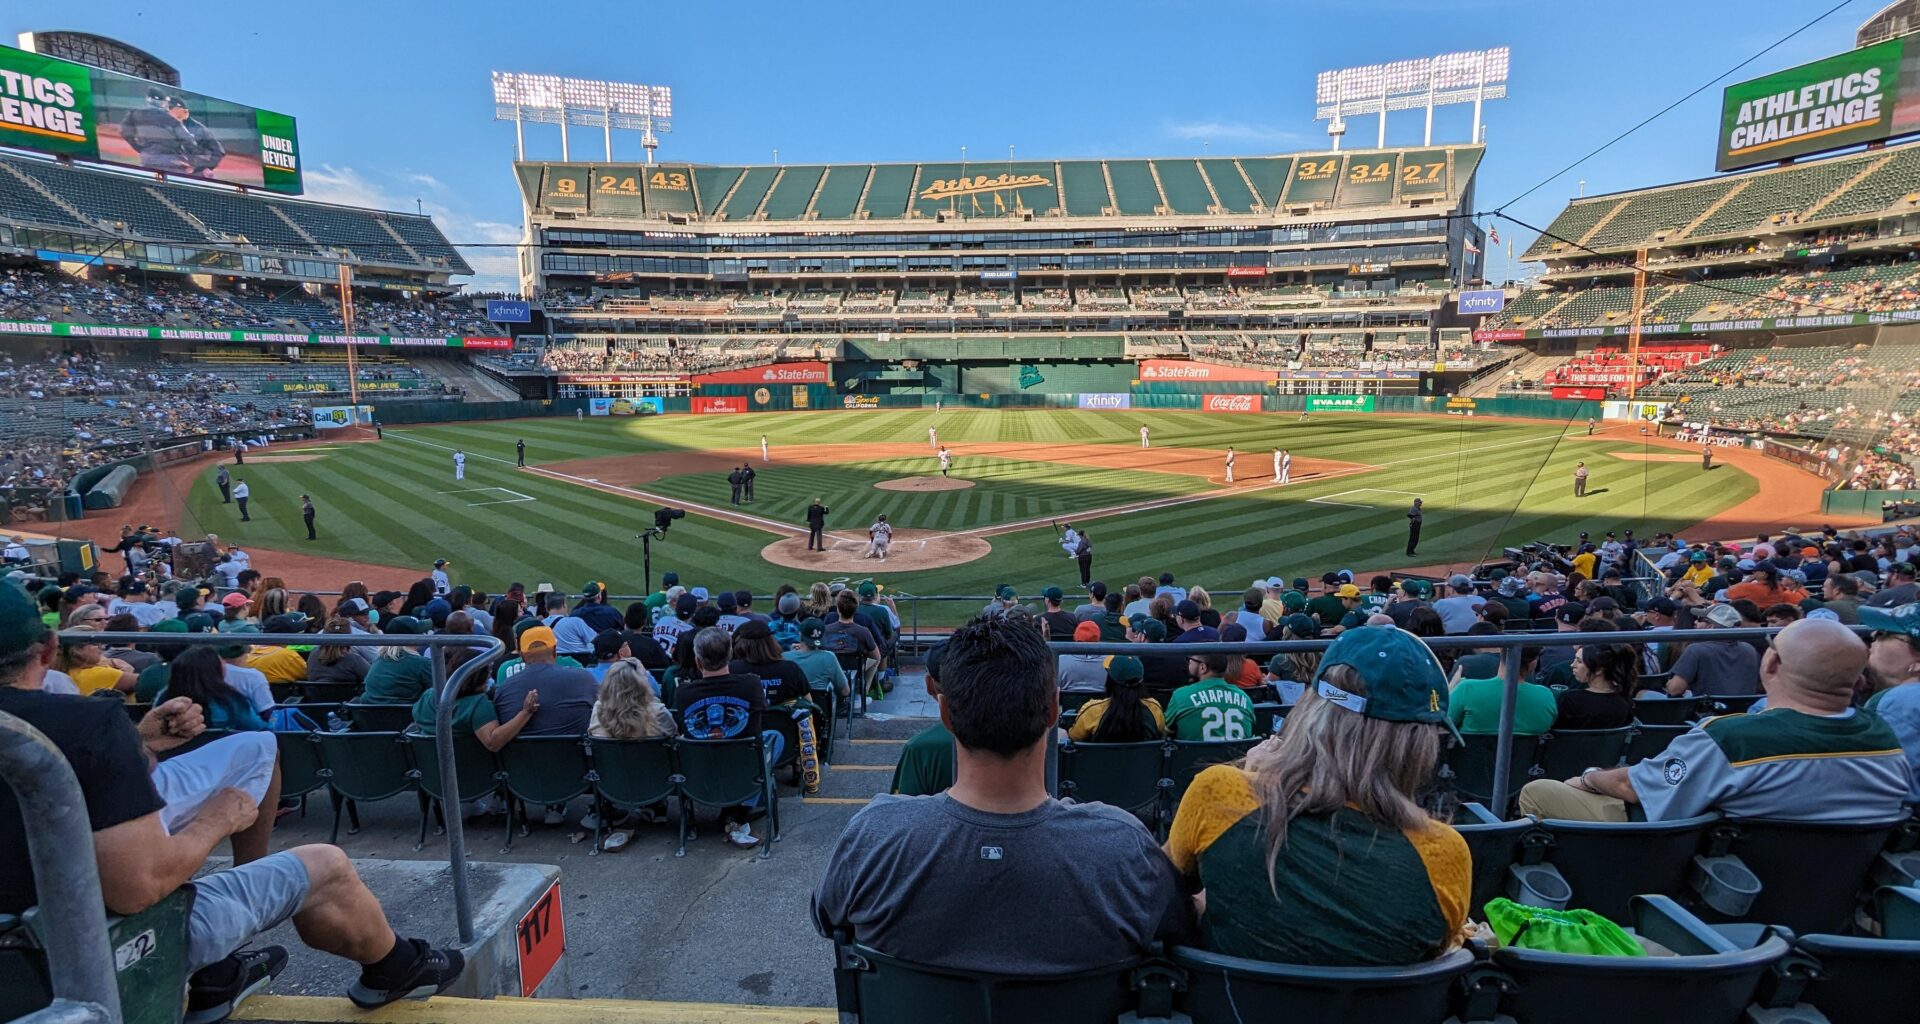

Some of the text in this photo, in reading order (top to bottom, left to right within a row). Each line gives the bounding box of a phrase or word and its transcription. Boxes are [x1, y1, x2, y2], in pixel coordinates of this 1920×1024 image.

[0, 69, 75, 108] TICS
[1736, 67, 1881, 125] ATHLETICS
[0, 96, 85, 136] ENGE
[1730, 93, 1883, 150] CHALLENGE
[262, 134, 293, 153] UNDER
[262, 150, 296, 168] REVIEW
[1298, 159, 1337, 177] 34
[1350, 162, 1391, 180] 34
[1403, 162, 1445, 181] 27
[650, 172, 687, 187] 43
[1299, 173, 1331, 181] FINGERS
[558, 178, 576, 193] 9
[600, 176, 638, 192] 24
[920, 174, 1050, 200] Athletics
[1464, 296, 1497, 309] xfinity
[494, 306, 524, 317] xfinity
[1869, 312, 1890, 322] CALL
[0, 322, 52, 333] DER REVIEW
[1691, 319, 1763, 331] CALL UNDER REVIEW
[1775, 314, 1854, 328] CALL UNDER REVIEW
[69, 325, 149, 337] CALL UNDER REVIEW
[160, 329, 231, 340] CALL UNDER REVIEW
[1543, 327, 1604, 337] CALL UNDER REVIEW
[1653, 324, 1680, 333] REVIEW
[244, 333, 309, 342] CALL UNDER REVIEW
[319, 335, 335, 343] CALL
[357, 336, 380, 344] REVIEW
[390, 337, 404, 345] CALL
[1609, 374, 1625, 382] FOR
[1626, 374, 1643, 382] YU
[1087, 395, 1122, 407] xfinity
[314, 410, 346, 422] Call 811
[1643, 405, 1657, 416] 811
[1189, 689, 1247, 709] CHAPMAN
[1201, 706, 1245, 742] 26
[518, 892, 552, 956] 117
